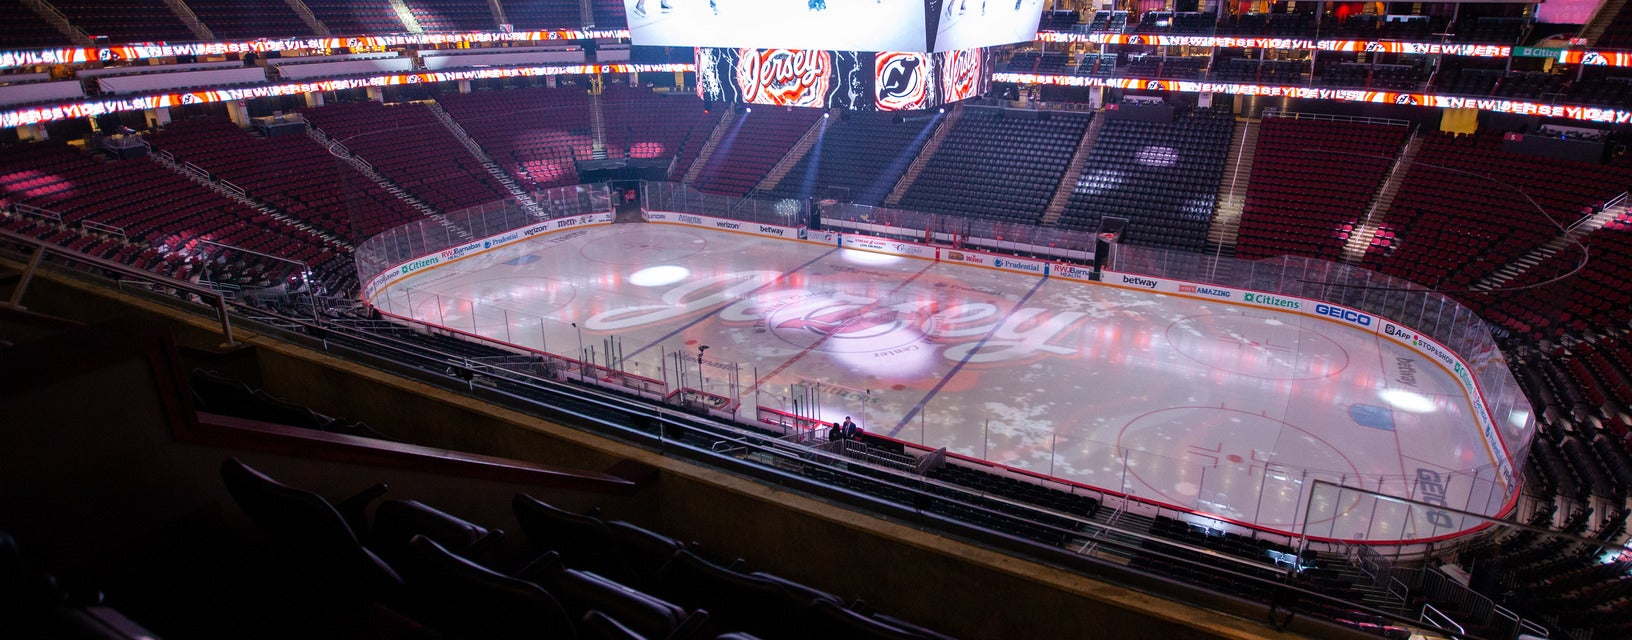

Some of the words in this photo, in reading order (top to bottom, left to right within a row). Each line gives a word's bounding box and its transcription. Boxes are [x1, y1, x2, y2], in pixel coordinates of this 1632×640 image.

[386, 35, 418, 45] NEW
[1208, 36, 1267, 48] JERSEY
[1269, 39, 1328, 50] DEVILS
[150, 45, 191, 57] NEW
[195, 41, 262, 55] JERSEY
[266, 38, 319, 51] DEVILS
[1418, 43, 1460, 55] NEW
[445, 71, 477, 81] NEW
[743, 49, 824, 103] Jersey
[230, 88, 268, 100] NEW
[272, 81, 330, 95] JERSEY
[1191, 82, 1227, 93] NEW
[1229, 84, 1294, 96] JERSEY
[1296, 87, 1356, 100] DEVILS
[2, 103, 79, 127] JERSEY
[81, 97, 145, 115] DEVILS
[1449, 97, 1494, 110] NEW
[1497, 100, 1578, 119] JERSEY
[524, 225, 547, 236] verizon
[717, 221, 740, 230] verizon
[760, 225, 784, 236] betway
[492, 233, 519, 246] Prudential
[408, 256, 439, 272] Citizens
[1005, 260, 1040, 272] Prudential
[1123, 275, 1158, 288] betway
[1197, 287, 1231, 298] AMAZING
[1255, 294, 1300, 309] Citizens
[1315, 304, 1371, 326] GEICO
[1417, 340, 1454, 365] STOP&SHOP
